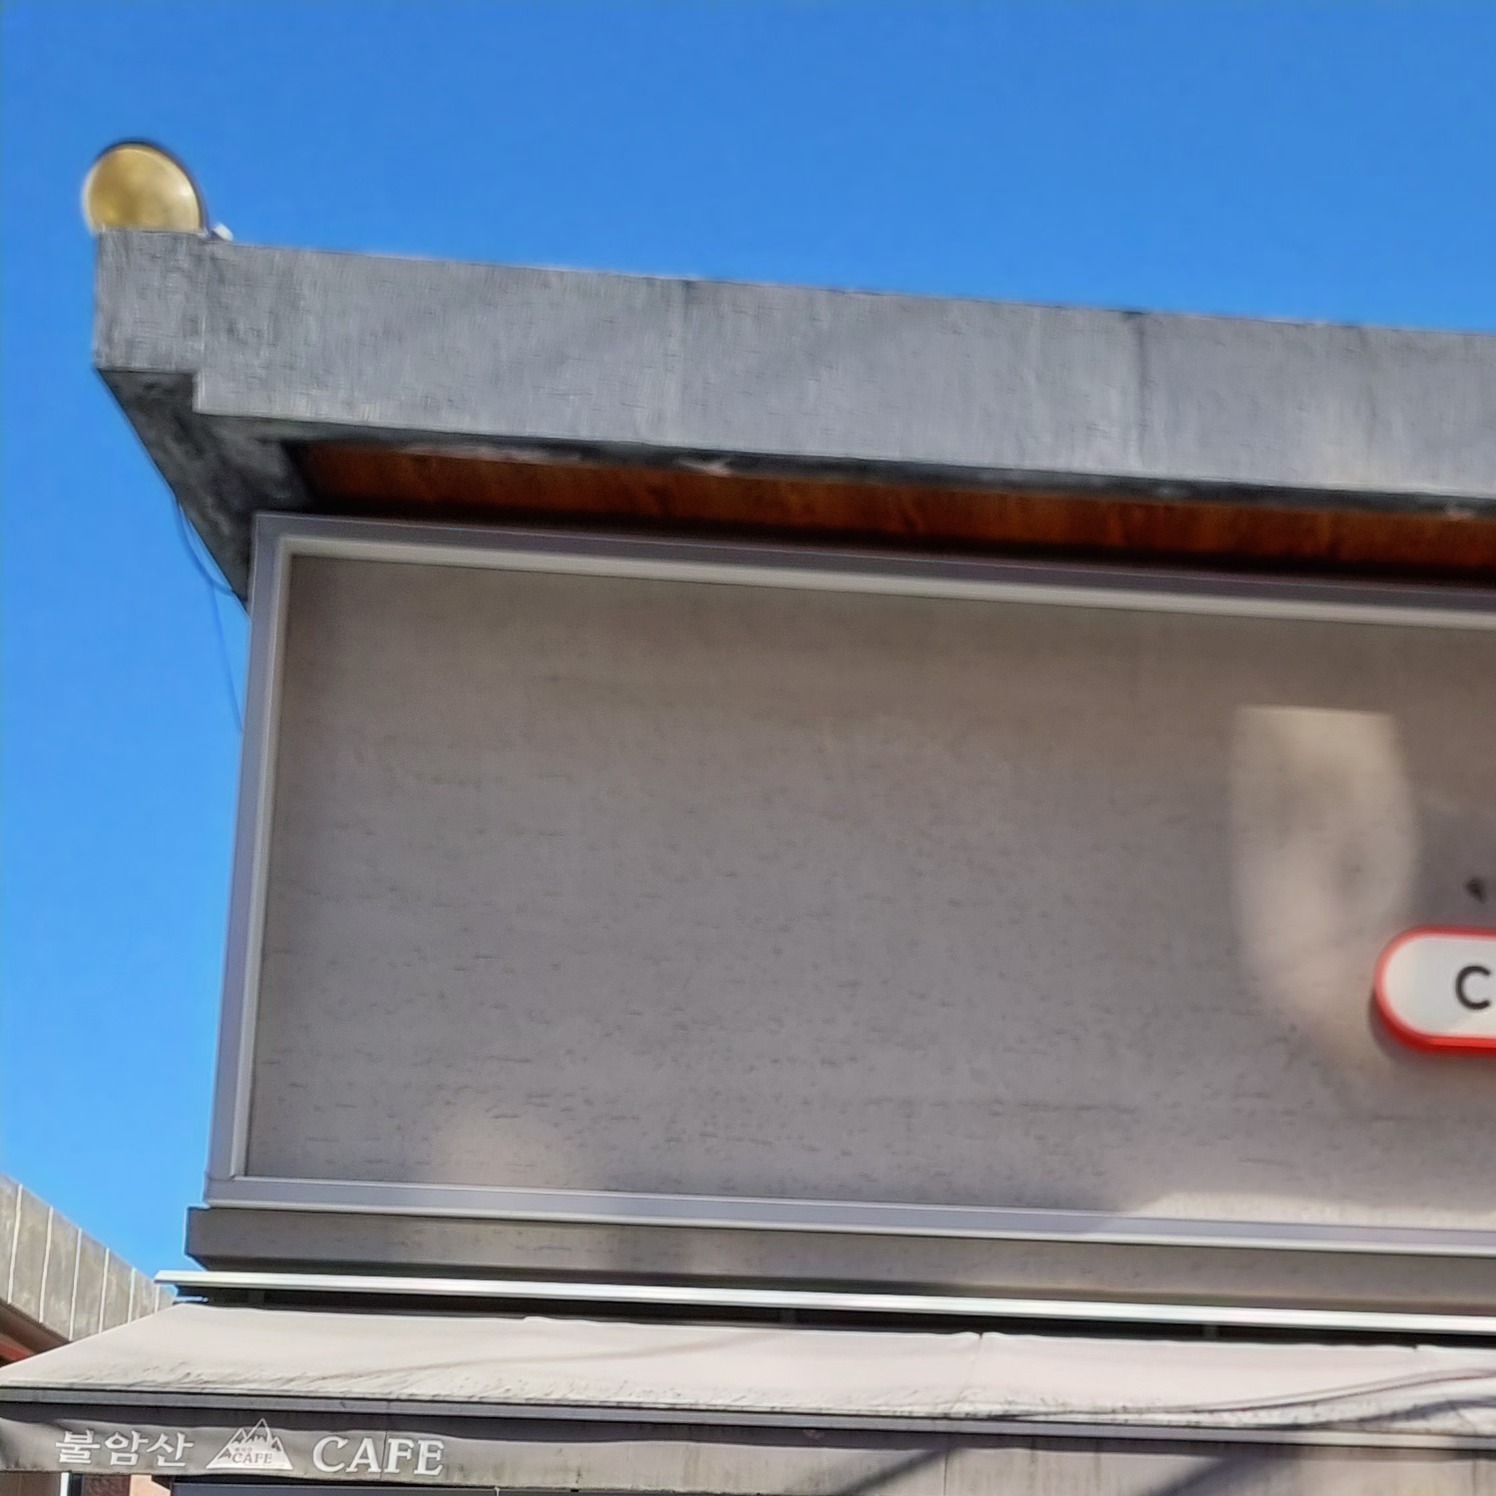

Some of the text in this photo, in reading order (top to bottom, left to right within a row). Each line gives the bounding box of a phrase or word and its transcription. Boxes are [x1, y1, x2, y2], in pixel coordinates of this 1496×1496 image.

[55, 1429, 445, 1477] 불암산 CAFE
[232, 1453, 272, 1464] CAFE
